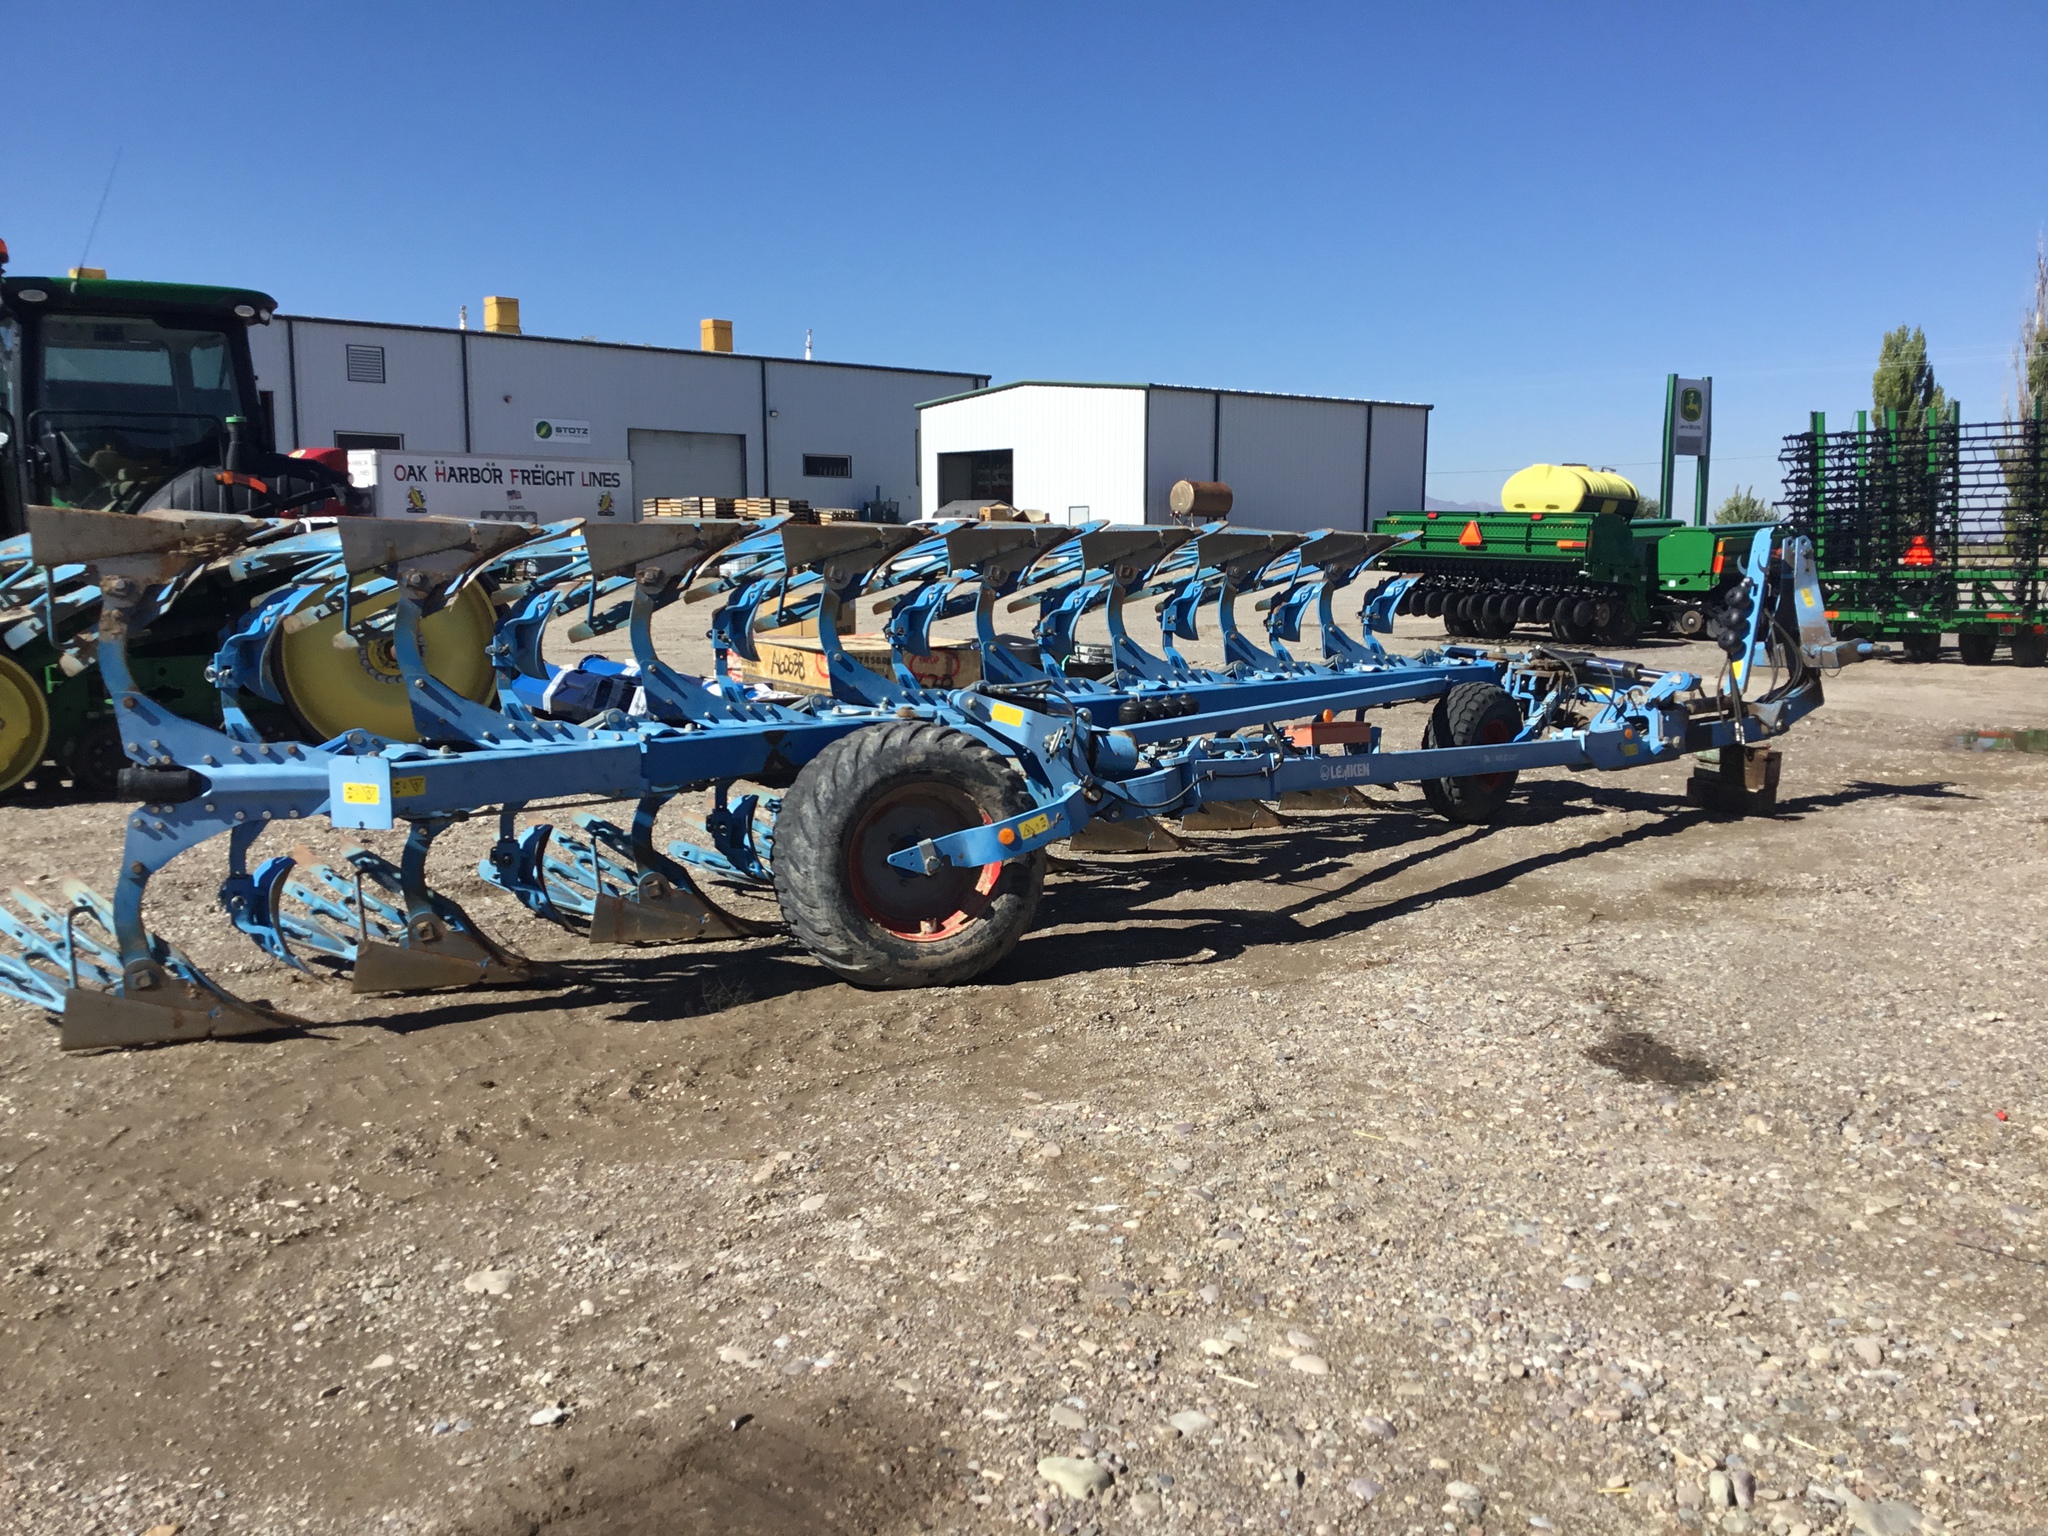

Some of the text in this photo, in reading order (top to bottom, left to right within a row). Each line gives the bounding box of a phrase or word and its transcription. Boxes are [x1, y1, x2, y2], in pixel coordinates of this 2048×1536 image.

[555, 426, 589, 435] STOTZ
[394, 464, 621, 488] OAK HARBOR FREIGHT LINES
[1330, 762, 1370, 781] LEMKEN
